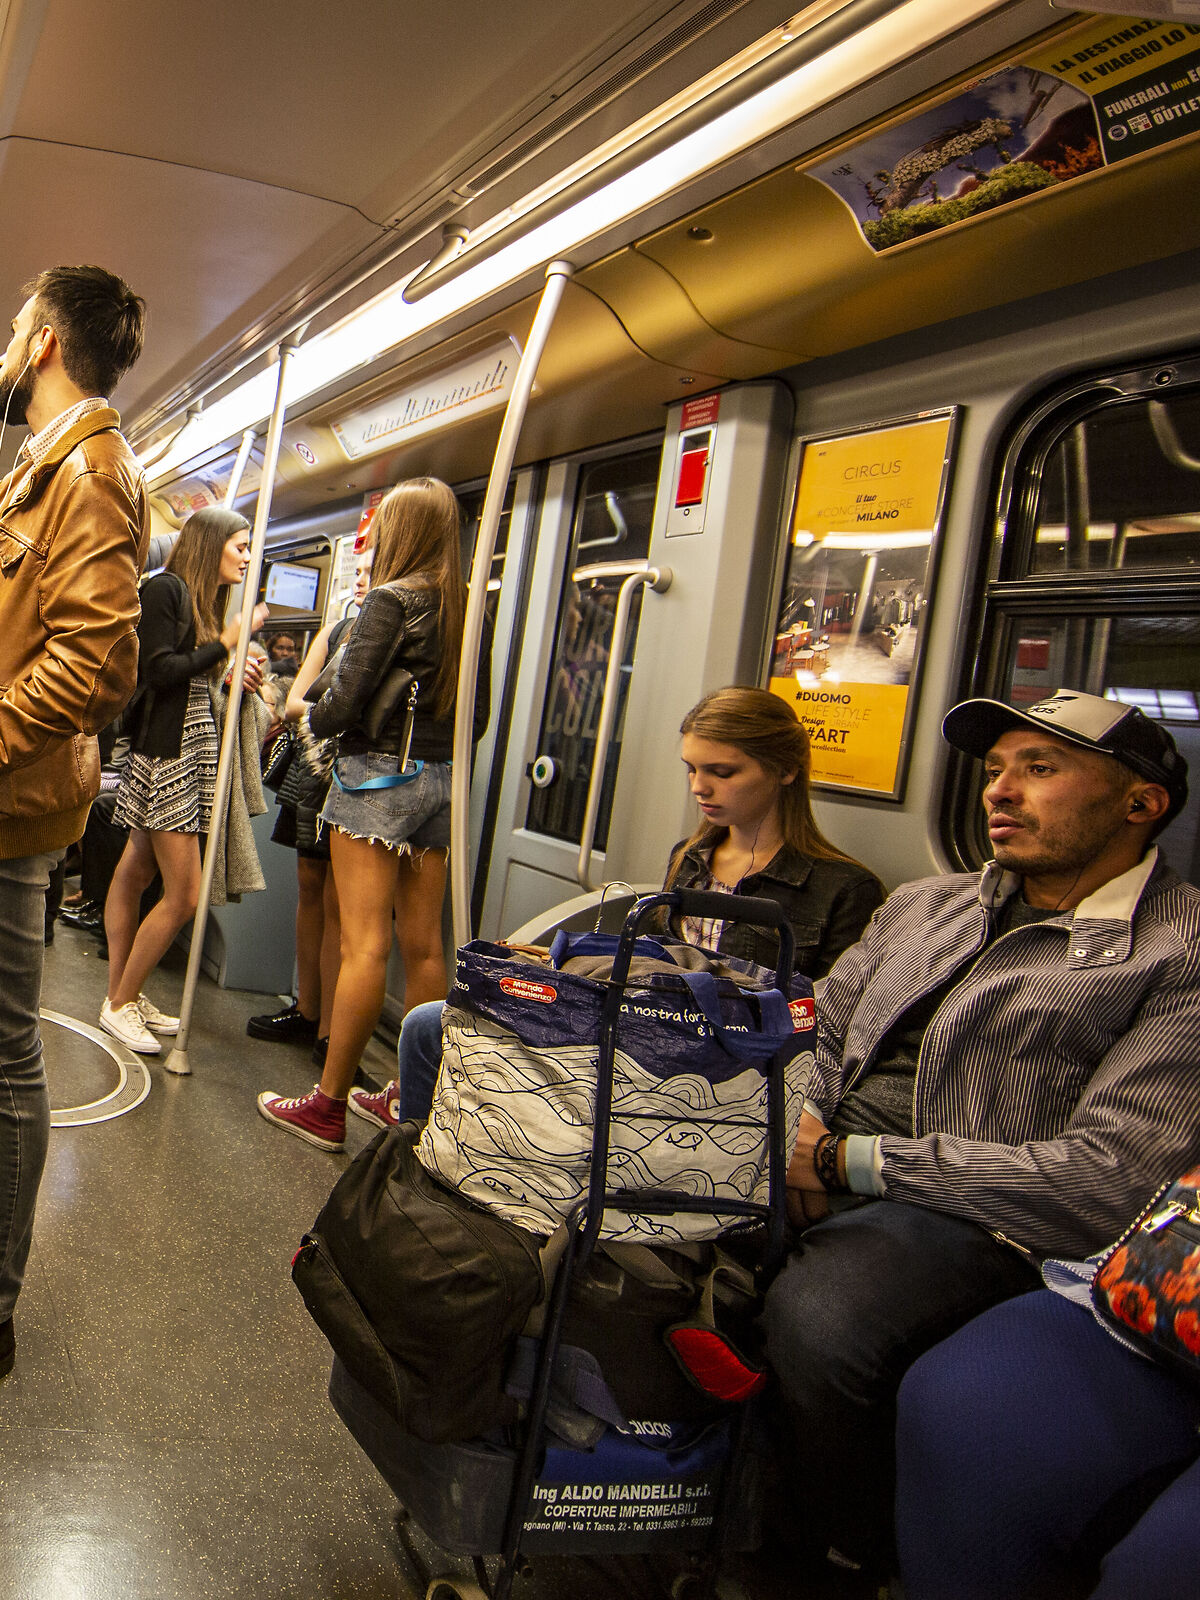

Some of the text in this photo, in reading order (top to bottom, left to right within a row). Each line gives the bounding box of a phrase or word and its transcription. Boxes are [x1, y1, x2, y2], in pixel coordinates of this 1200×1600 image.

[1051, 20, 1164, 73] LA DESTINAZ
[1077, 71, 1097, 84] IL
[1093, 40, 1164, 76] VIAGGIO
[1161, 29, 1186, 46] LO
[1104, 81, 1170, 118] FUNERALI
[844, 460, 902, 480] CIRCUS
[878, 498, 914, 511] STORE
[856, 509, 899, 522] MILANO
[796, 691, 851, 704] #DUOMO
[805, 705, 872, 720] LIFE STYLE
[801, 716, 825, 726] Design
[808, 727, 850, 744] #ART
[810, 744, 847, 753] wcollection
[503, 985, 552, 1001] Convenienza
[513, 981, 543, 992] Mondo
[634, 1005, 681, 1022] nostra
[683, 1008, 708, 1023] forz
[532, 1485, 558, 1503] Ing
[560, 1485, 604, 1500] ALDO
[607, 1484, 682, 1500] MANDELLI
[544, 1502, 698, 1518] COPERTURE IMPERMEABILI
[523, 1522, 551, 1531] egnano
[552, 1521, 566, 1532] (MI)
[573, 1522, 584, 1531] Via
[594, 1522, 616, 1532] Tasso,
[617, 1522, 627, 1531] 22
[633, 1521, 644, 1531] Tel.
